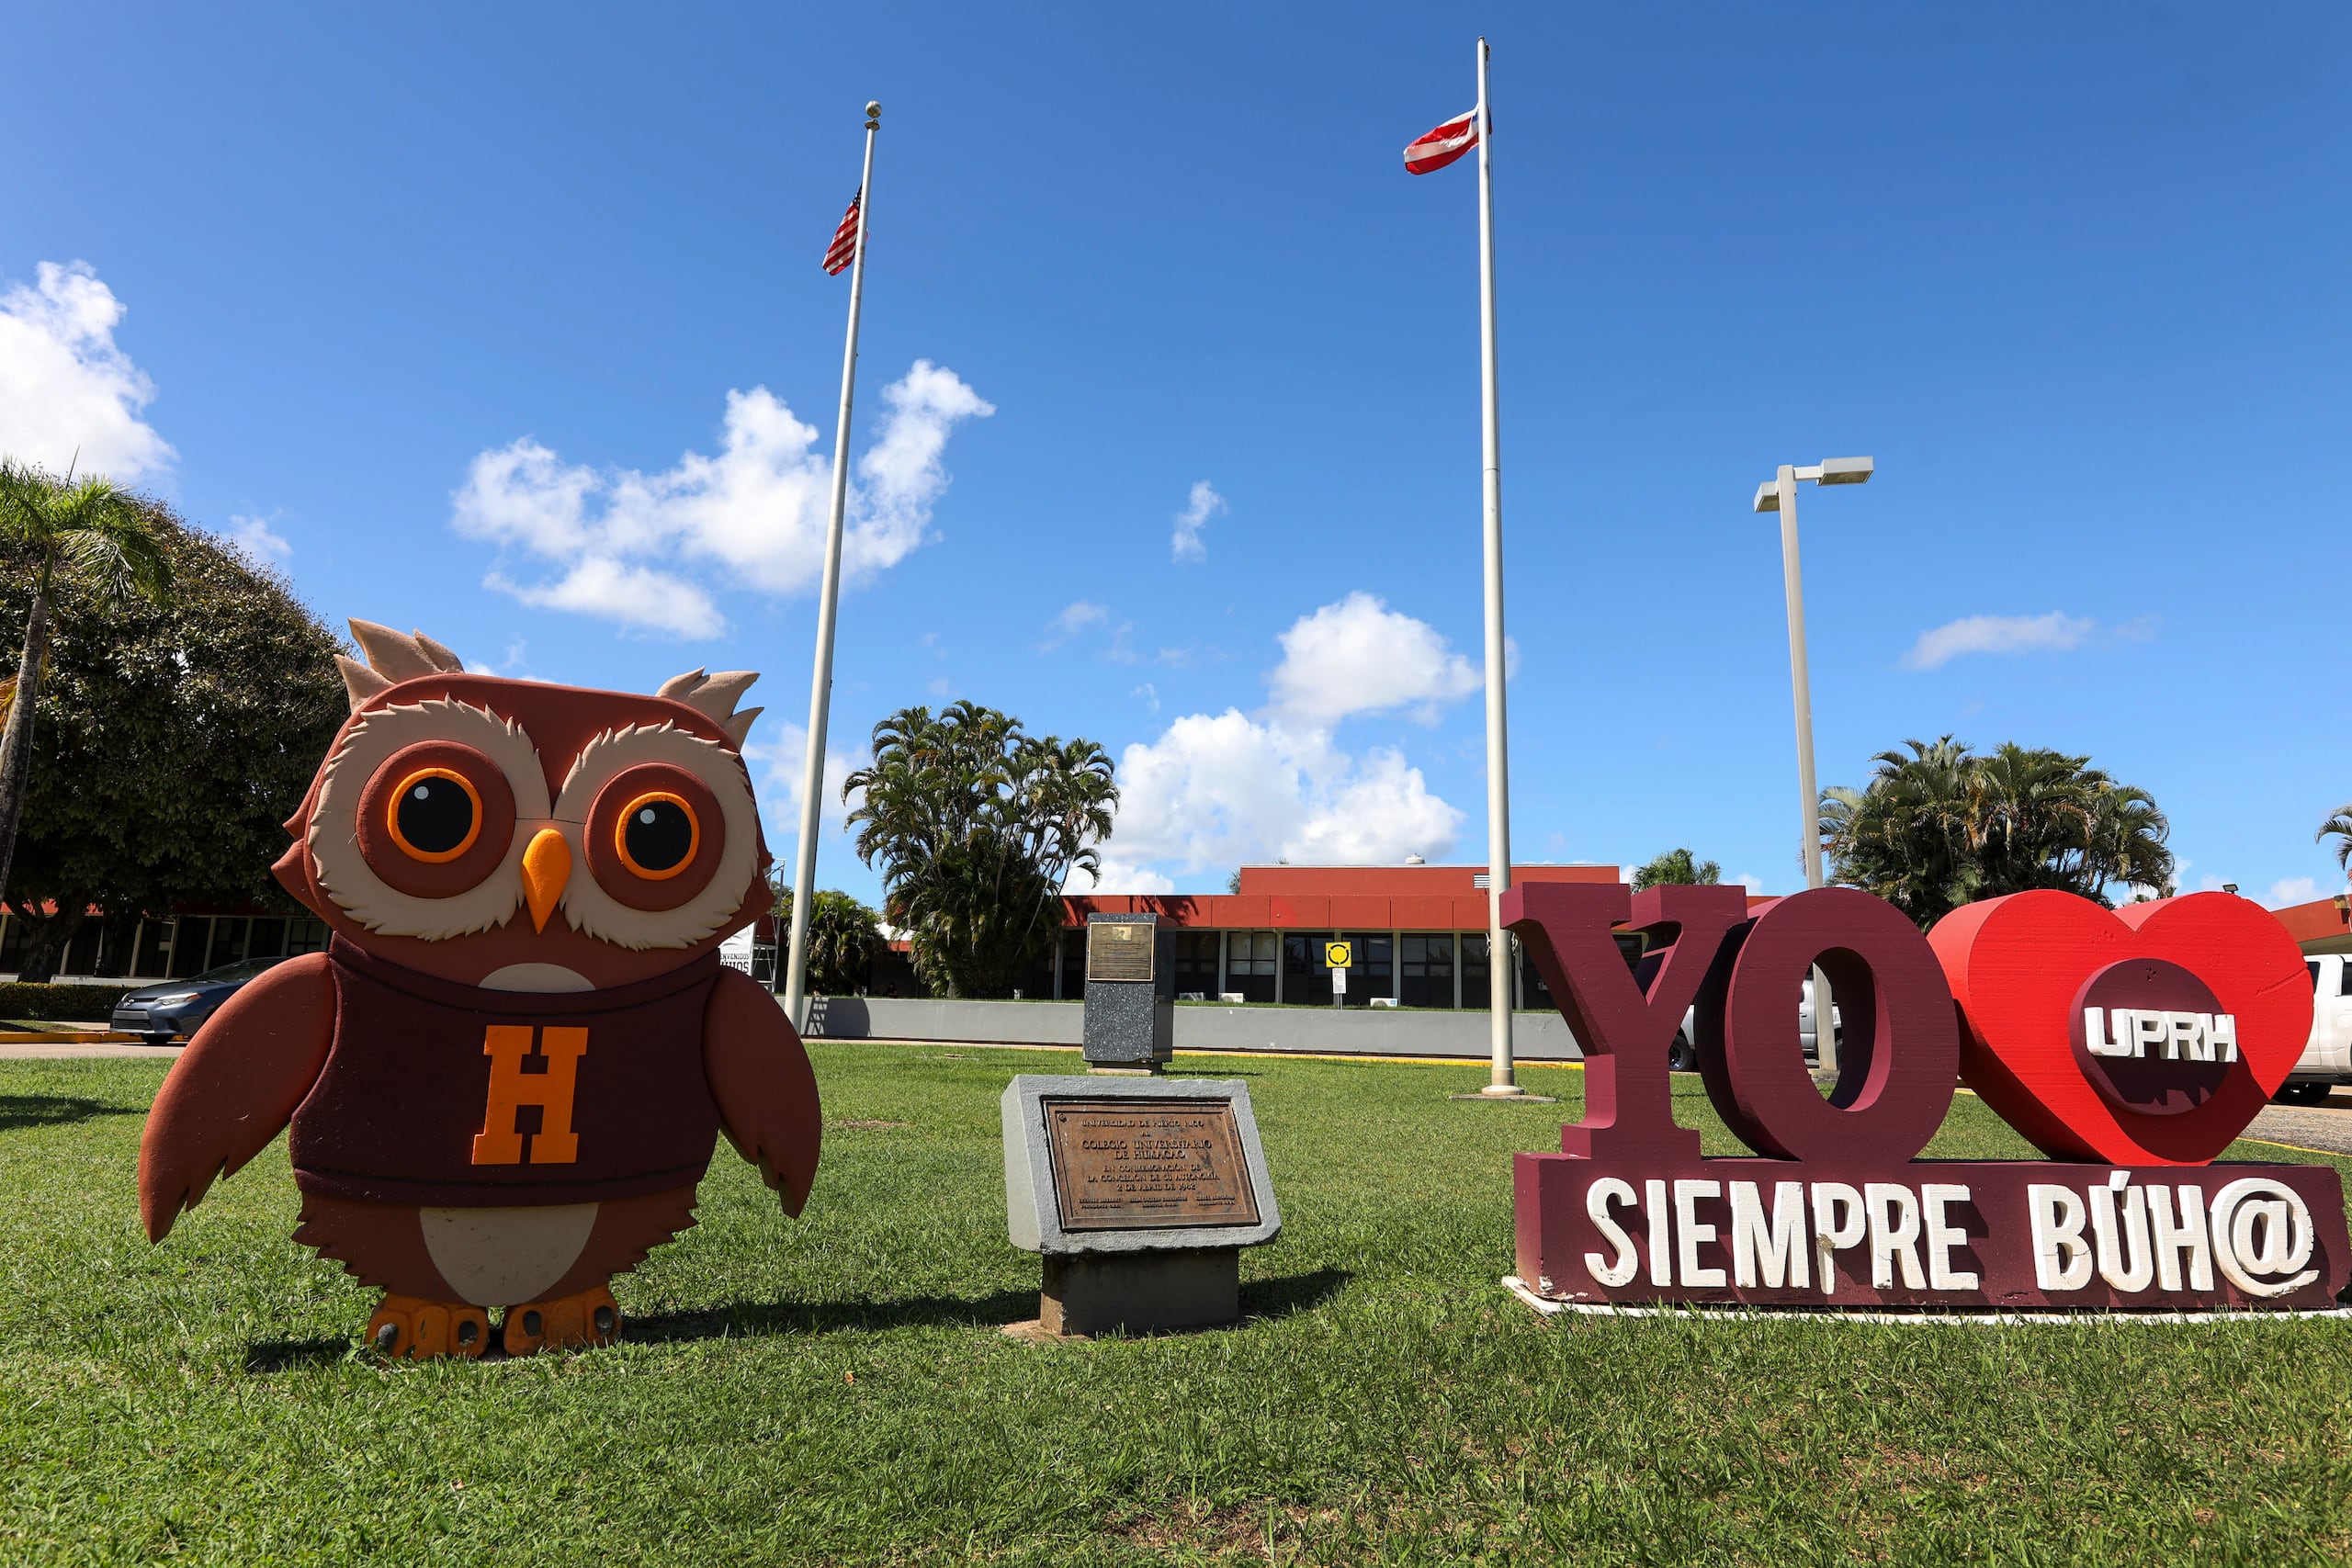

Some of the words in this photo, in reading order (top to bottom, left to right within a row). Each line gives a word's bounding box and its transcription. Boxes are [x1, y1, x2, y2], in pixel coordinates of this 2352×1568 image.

[1499, 882, 1960, 1162] YO
[2085, 1007, 2238, 1063] UPRH
[471, 1025, 589, 1165] H
[1138, 1120, 1150, 1128] DE
[1081, 1140, 1128, 1150] COLEGIO
[1132, 1139, 1212, 1150] UNIVERSITARIO
[1114, 1151, 1129, 1160] DE
[1134, 1150, 1186, 1160] HUMACAO
[1584, 1177, 1979, 1294] SIEMPRE
[2028, 1170, 2320, 1298] BÚH@
